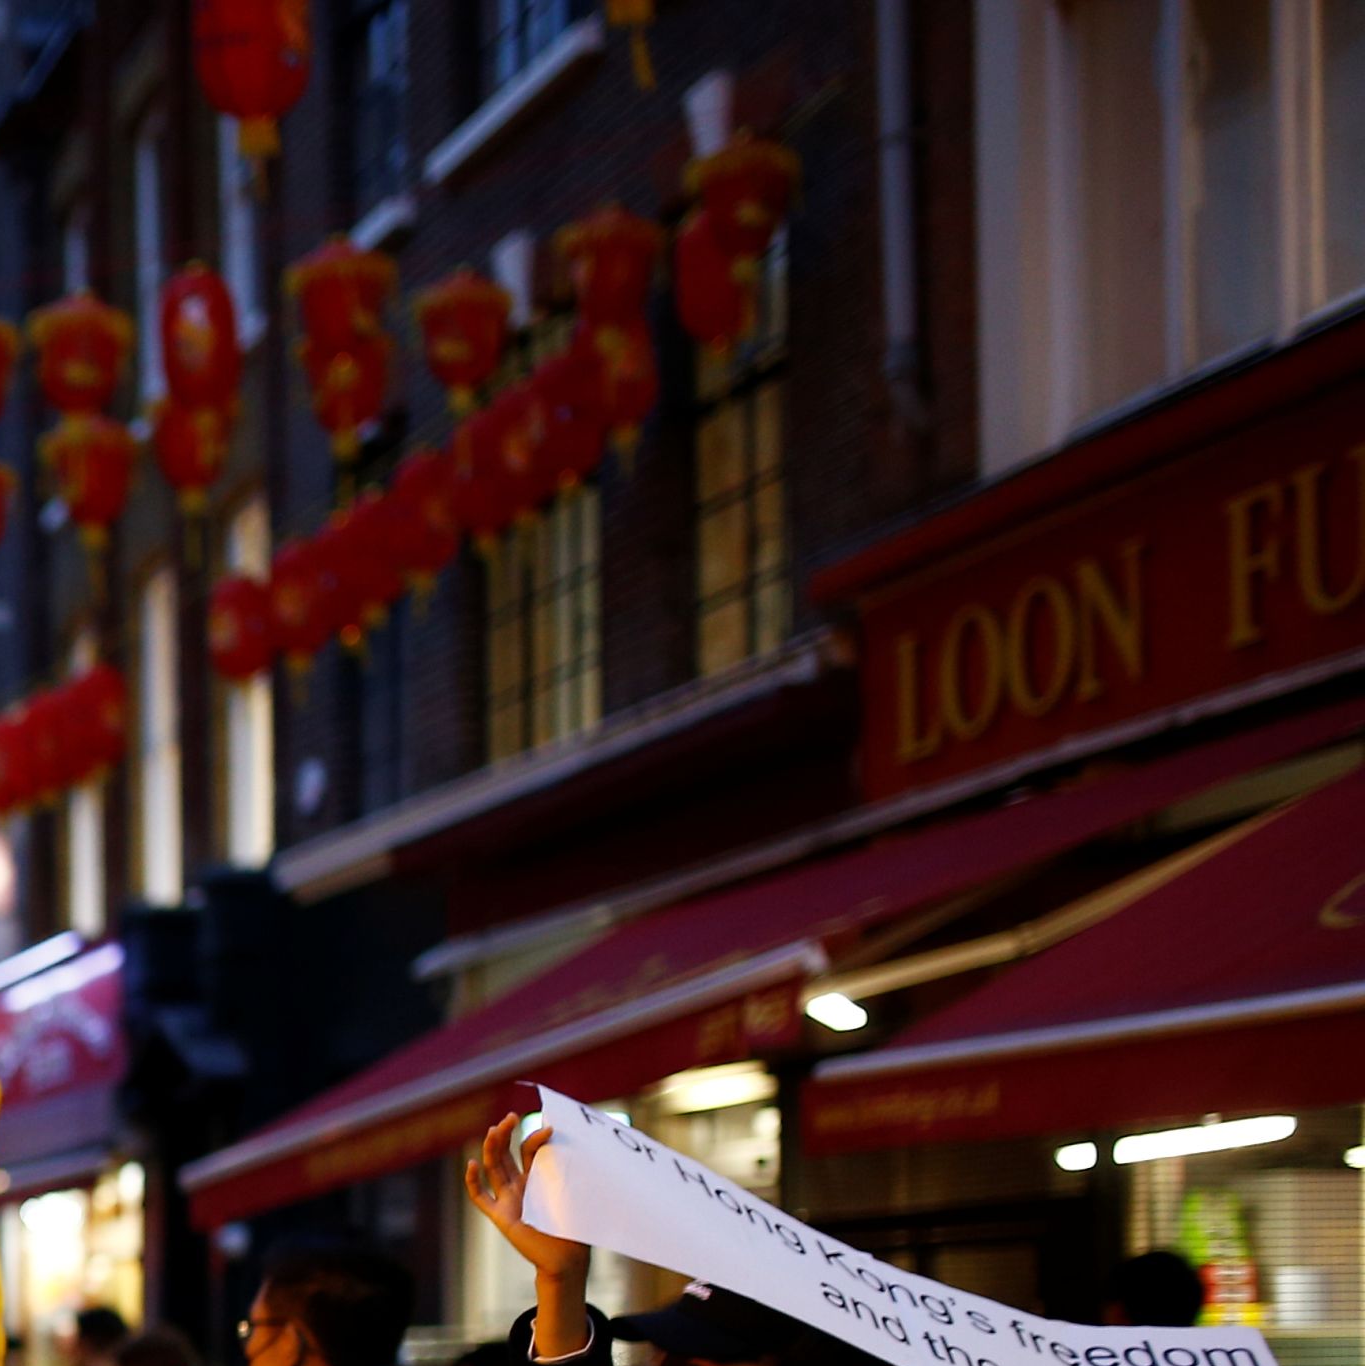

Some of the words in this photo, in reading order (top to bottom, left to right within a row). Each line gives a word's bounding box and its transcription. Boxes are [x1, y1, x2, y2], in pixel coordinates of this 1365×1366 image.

[895, 537, 1145, 765] LOON
[673, 1158, 807, 1256] Hong
[817, 1239, 997, 1335] Kong's
[820, 1281, 911, 1345] and
